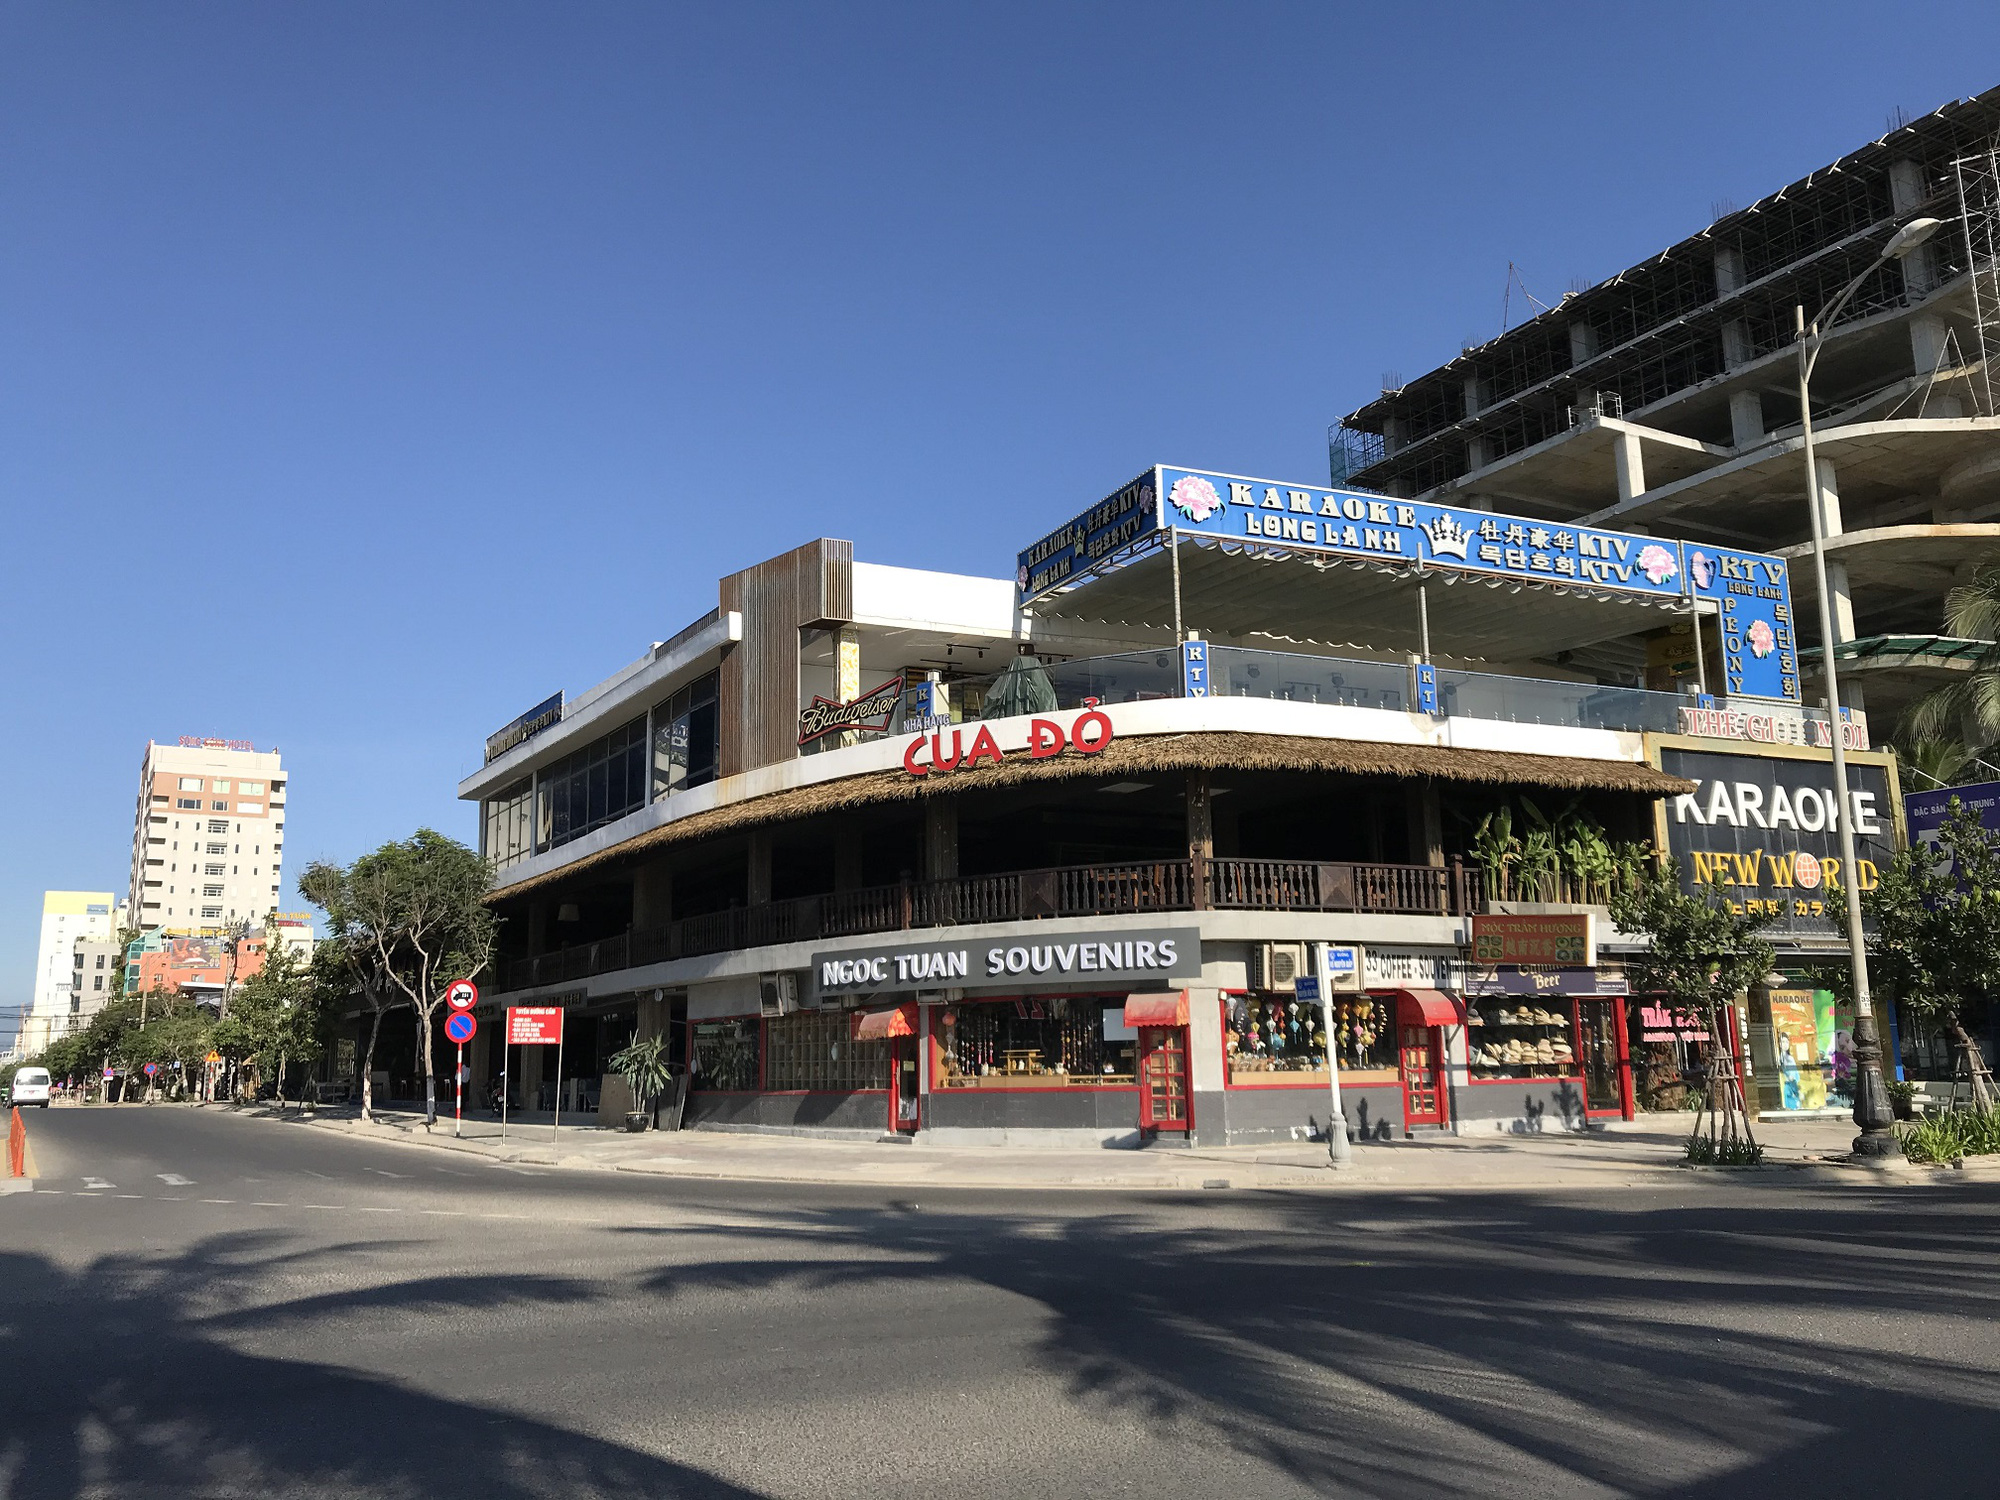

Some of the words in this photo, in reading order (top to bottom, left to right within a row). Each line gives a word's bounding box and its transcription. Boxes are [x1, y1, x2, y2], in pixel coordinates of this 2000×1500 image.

[1119, 482, 1141, 514] KTV
[1229, 482, 1416, 529] KARAOKE
[1028, 525, 1075, 568] KARAOKE
[1121, 513, 1141, 541] KTV
[1246, 512, 1317, 543] LONG
[1323, 523, 1402, 553] LANH
[1478, 518, 1576, 553] 牡丹豪华
[1577, 532, 1631, 561] KTV
[1479, 544, 1577, 577] 목단호화
[1579, 558, 1633, 583] KTV
[1717, 554, 1785, 586] KTV
[1727, 580, 1754, 596] LONG
[1755, 585, 1784, 601] LANH
[1723, 596, 1744, 694] PEONY
[1774, 603, 1796, 700] 목단호화
[1187, 646, 1206, 698] KTV
[801, 696, 900, 735] Budweiser
[903, 715, 923, 732] NHÀ
[923, 713, 950, 730] HÀNG
[903, 724, 1005, 776] CUA
[1027, 696, 1114, 759] ĐỎ
[1674, 779, 1881, 835] KARAOKE
[1968, 798, 1995, 810] TRUNG
[1690, 848, 1763, 887] NEW
[821, 956, 889, 987] NGOC
[894, 949, 968, 981] TUAN
[987, 939, 1179, 975] SOUVENIRS
[1365, 949, 1378, 972] 33
[1380, 953, 1413, 980] COFFEE
[1532, 973, 1560, 990] Beer
[1772, 995, 1811, 1004] KARAOKE
